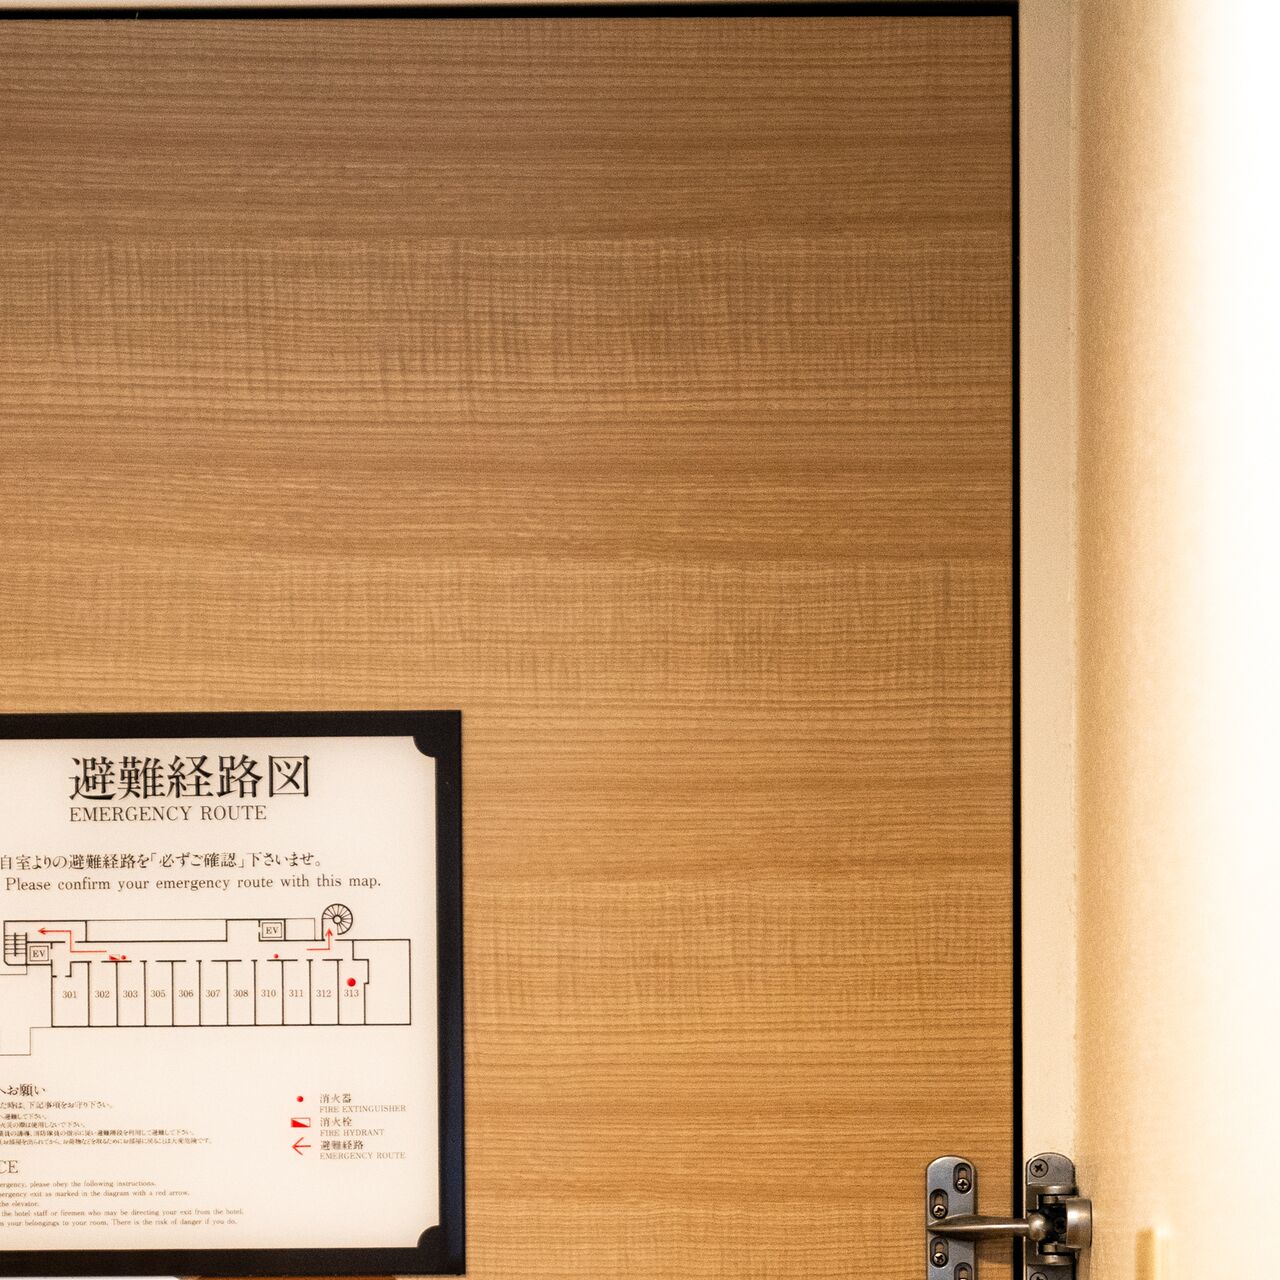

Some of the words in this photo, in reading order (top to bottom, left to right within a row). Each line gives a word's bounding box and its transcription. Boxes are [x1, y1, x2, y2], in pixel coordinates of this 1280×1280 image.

[68, 754, 310, 800] 避難経路図
[69, 806, 193, 822] EMERGENCY
[200, 804, 267, 821] ROUTE
[5, 877, 51, 891] Please
[57, 877, 111, 891] confirm
[118, 880, 150, 892] your
[155, 878, 230, 891] emergency
[237, 877, 274, 888] route
[280, 875, 310, 888] with
[316, 874, 342, 887] this
[349, 877, 382, 889] map.
[62, 991, 77, 999] 301
[123, 990, 138, 998] 303
[150, 990, 166, 998] 305
[178, 990, 194, 998] 306
[344, 989, 359, 997] 313
[320, 1093, 352, 1104] 消火器
[320, 1105, 339, 1113] FIRE
[342, 1105, 407, 1113] EXTINGUISHER
[320, 1117, 352, 1127] 消火栓
[343, 1129, 385, 1137] HYDRANT
[320, 1140, 364, 1151] 避難経路
[320, 1152, 373, 1160] EMERGENCY
[30, 1181, 50, 1189] please
[84, 1180, 114, 1188] following
[103, 1190, 129, 1198] diagram
[131, 1209, 159, 1217] directing
[25, 1220, 60, 1228] belongings
[180, 1219, 202, 1227] danger
